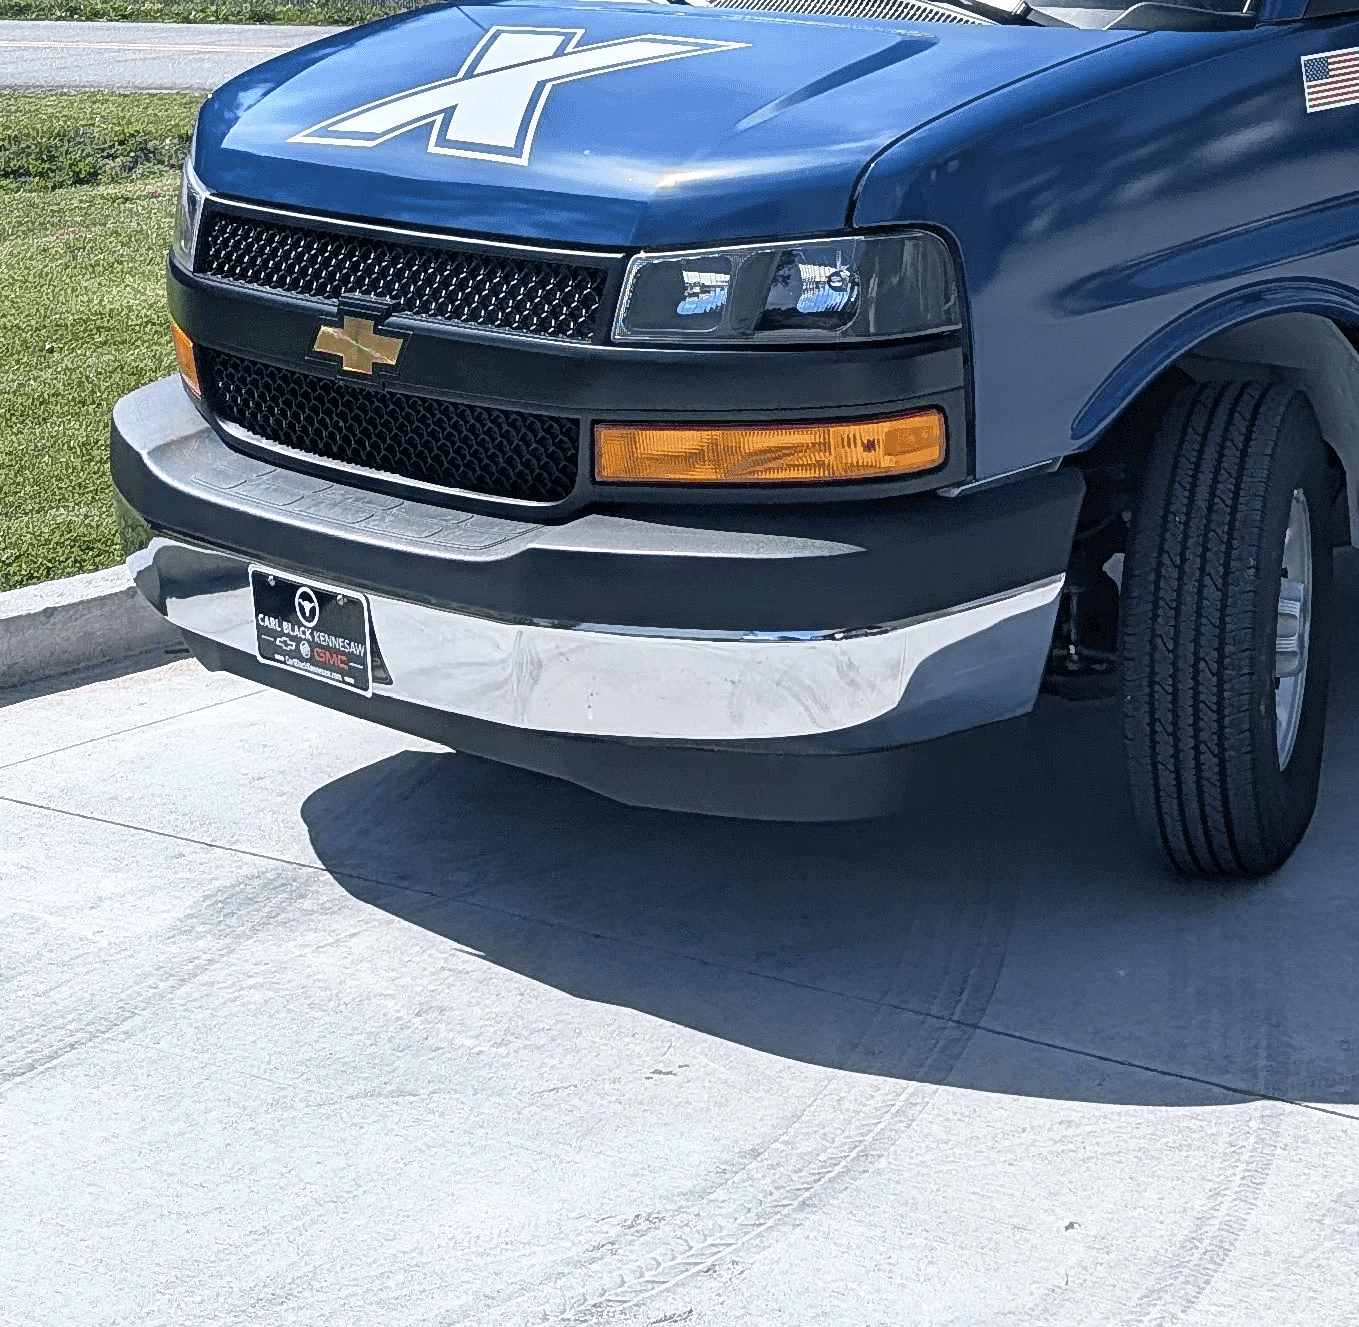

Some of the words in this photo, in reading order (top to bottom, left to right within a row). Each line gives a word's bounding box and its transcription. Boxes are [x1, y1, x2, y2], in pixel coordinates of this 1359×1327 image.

[286, 25, 753, 167] X
[257, 614, 281, 631] CARL
[282, 622, 312, 641] BLACK
[313, 631, 365, 657] KENNESAW
[313, 647, 348, 669] GMC
